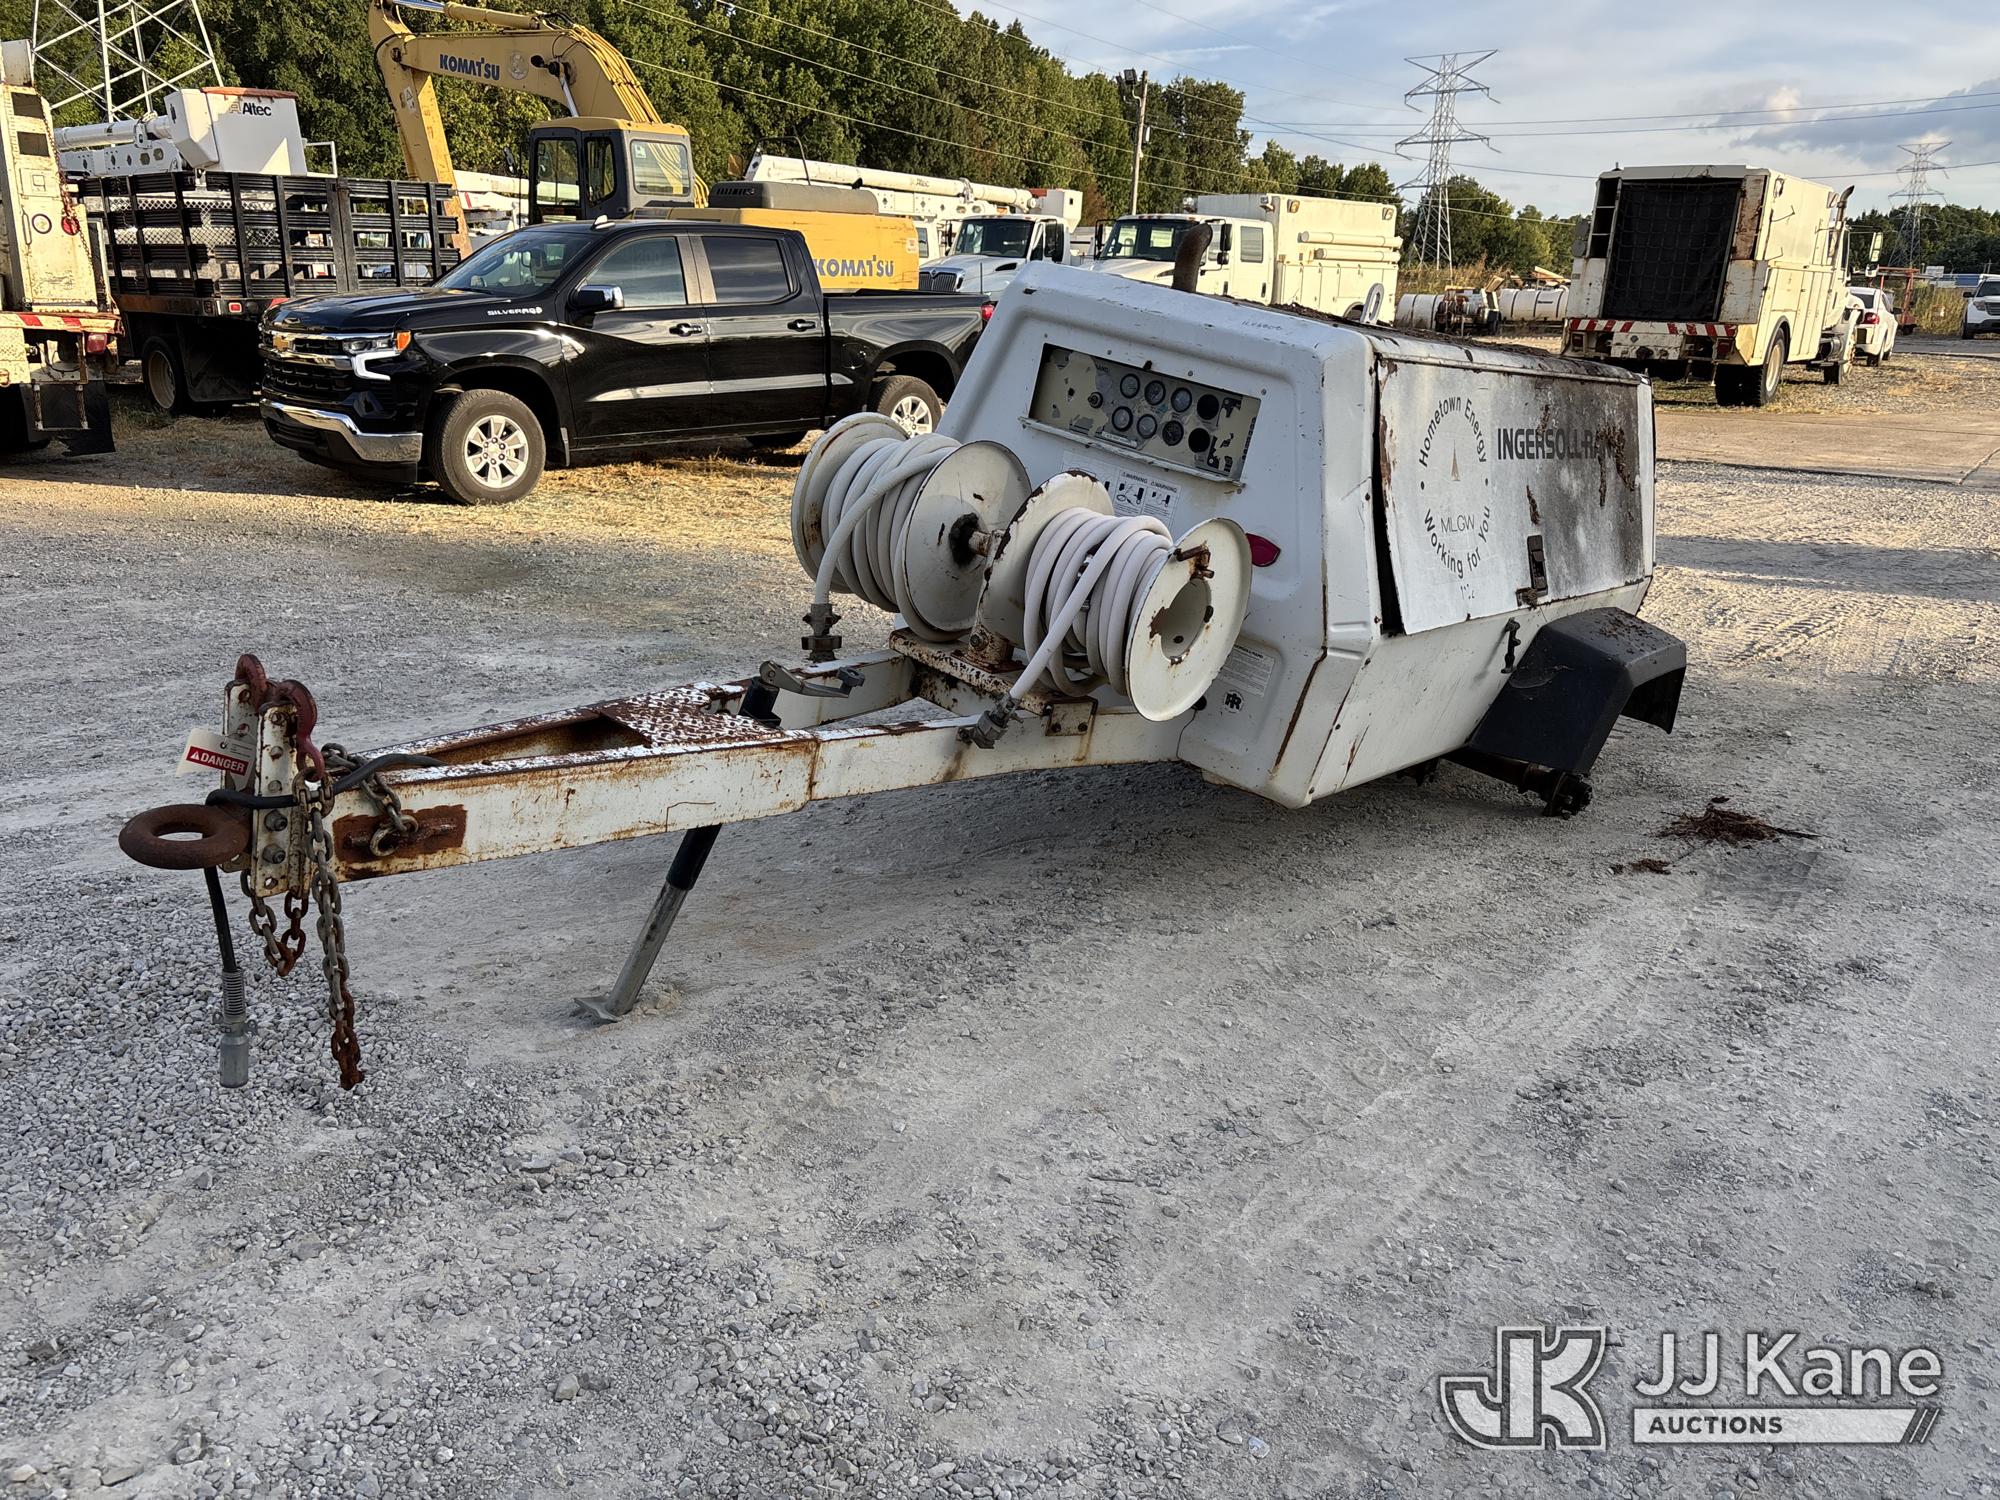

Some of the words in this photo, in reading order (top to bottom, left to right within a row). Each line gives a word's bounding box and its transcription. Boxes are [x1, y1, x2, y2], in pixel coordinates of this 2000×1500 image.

[439, 54, 500, 80] KOMATSU
[242, 102, 272, 116] Altec
[812, 254, 894, 277] KOMATSU
[487, 306, 543, 316] SILVERADO
[1419, 396, 1462, 467] Hometown
[1464, 398, 1487, 463] Energy
[1440, 514, 1475, 533] MLGW
[1424, 508, 1464, 579] Working
[1467, 547, 1482, 572] for
[200, 752, 246, 773] DANGER
